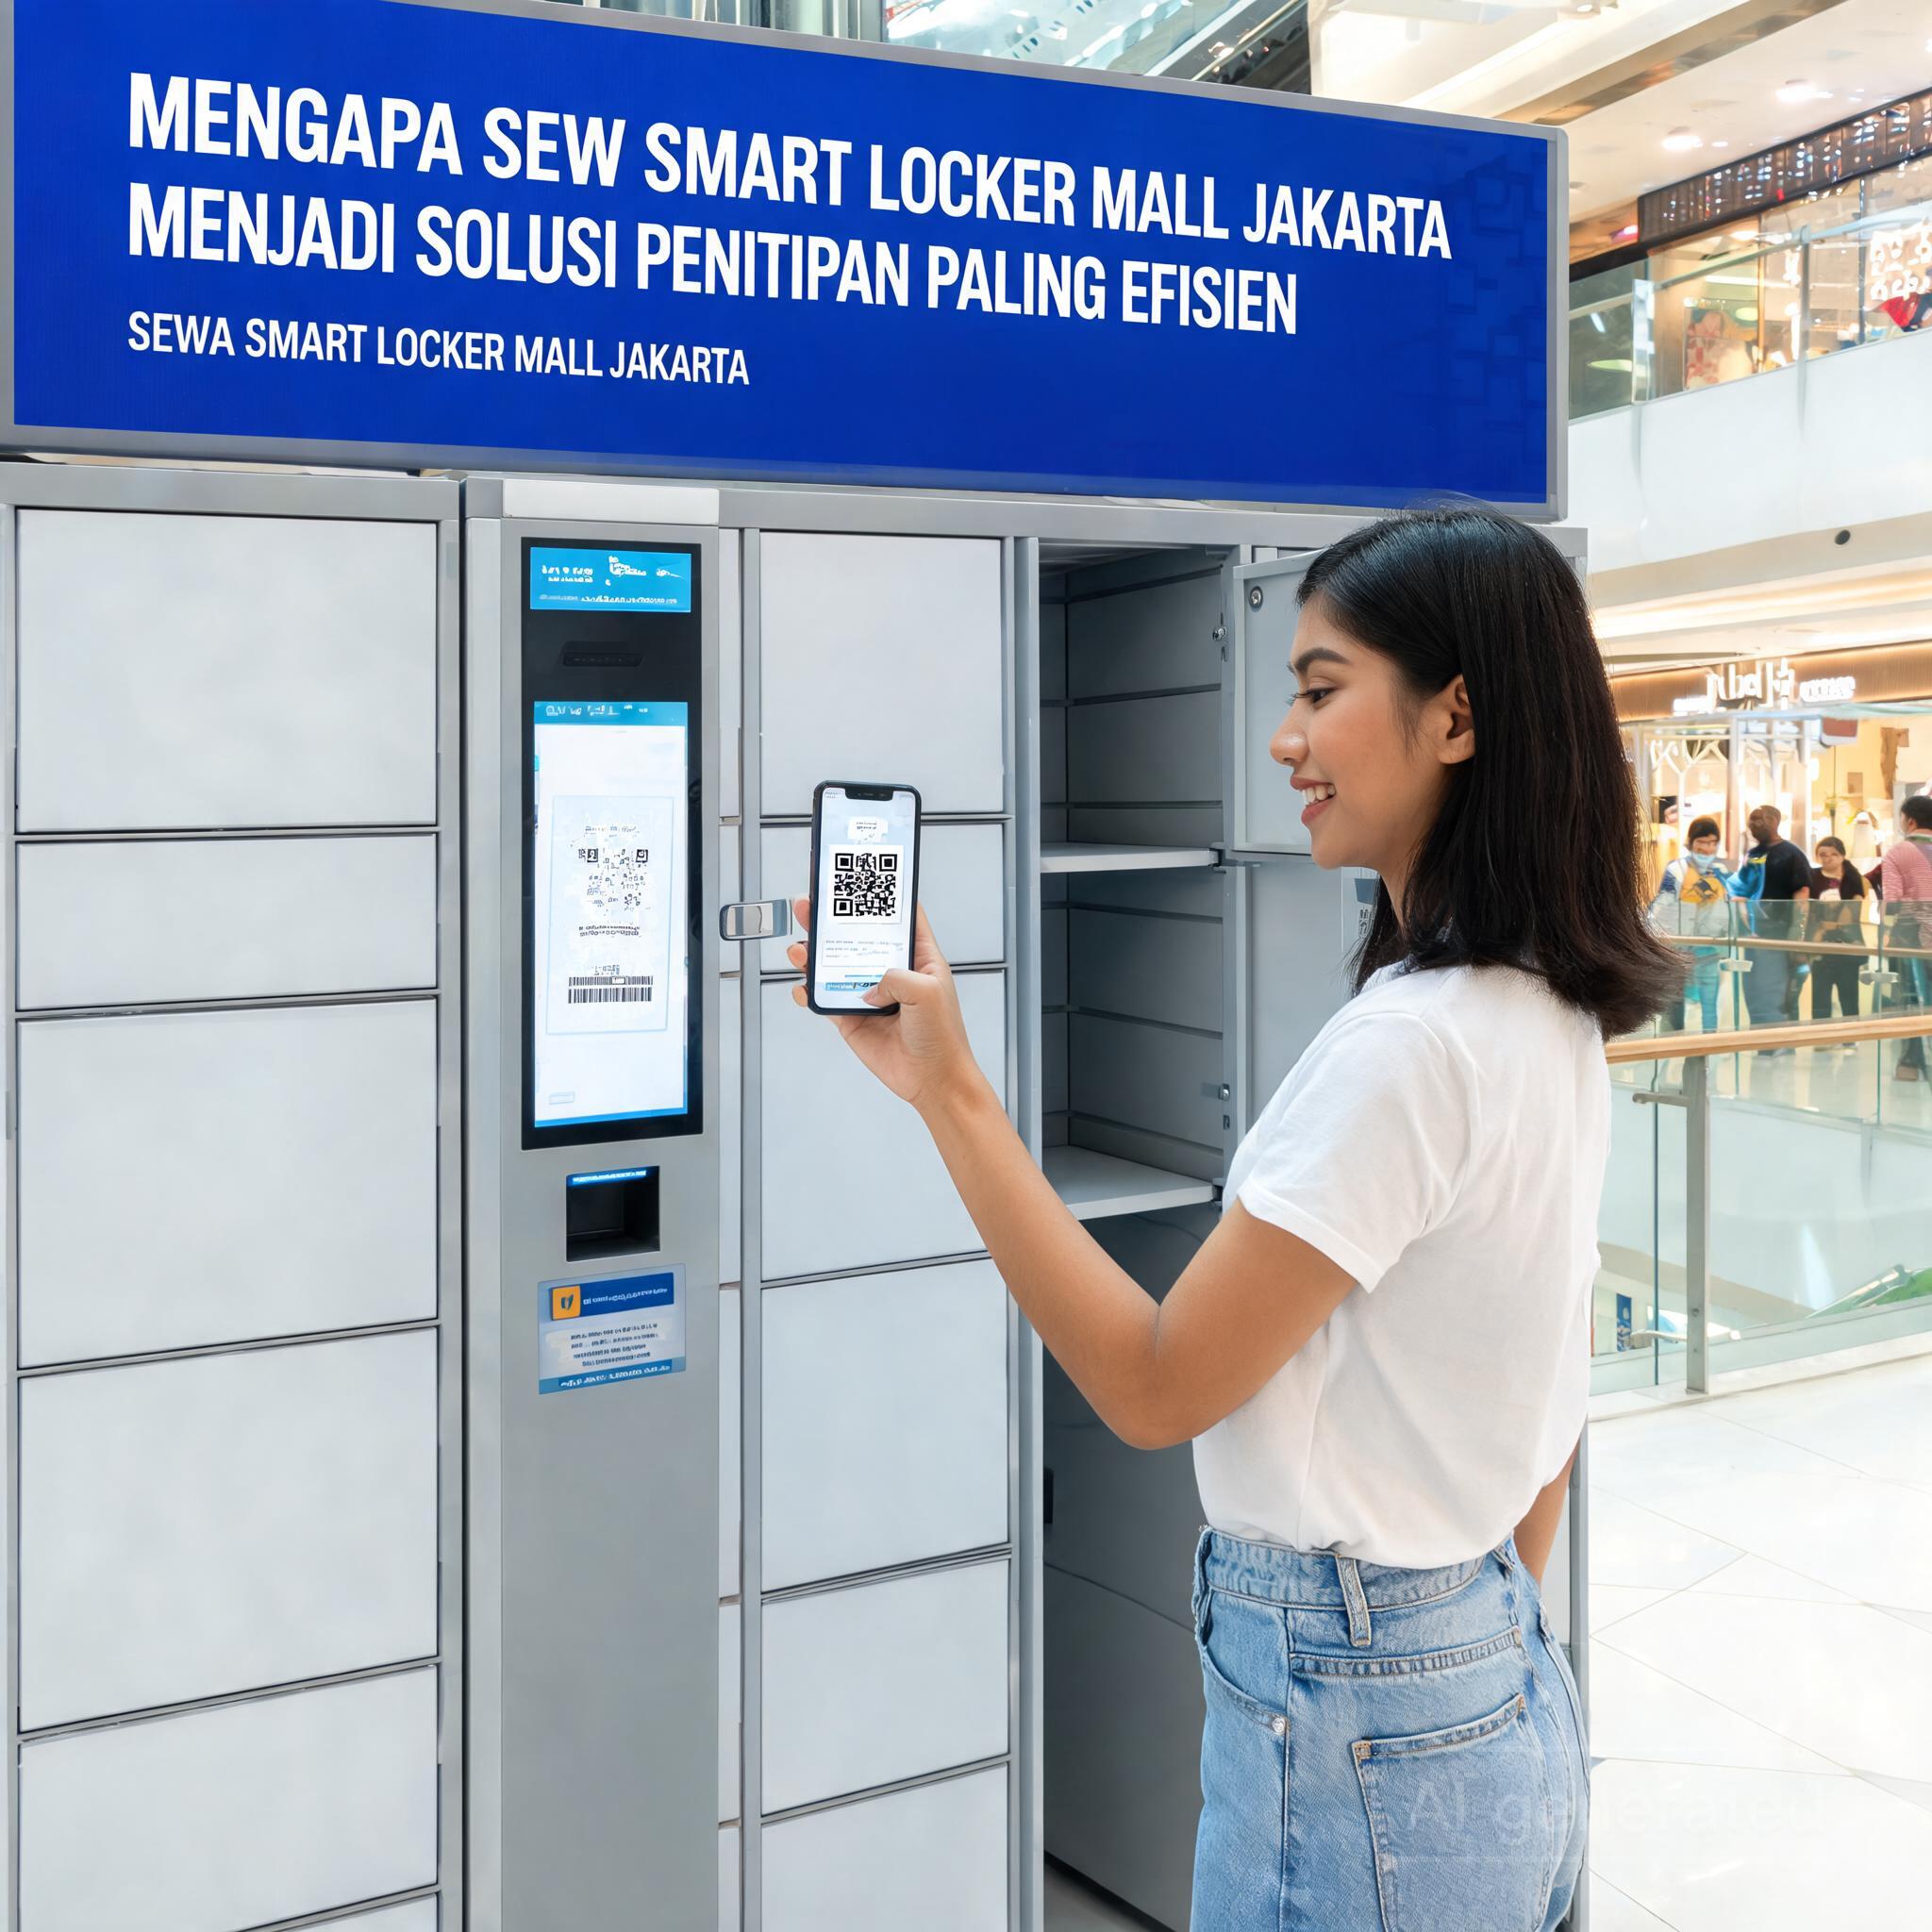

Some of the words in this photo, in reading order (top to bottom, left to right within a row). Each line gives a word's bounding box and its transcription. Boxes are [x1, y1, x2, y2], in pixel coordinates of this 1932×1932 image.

[129, 72, 463, 175] MENGAPA
[483, 107, 626, 188] SEW
[644, 122, 852, 206] SMART
[870, 144, 1075, 226] LOCKER
[1092, 165, 1229, 240] MALL
[1242, 183, 1453, 259] JAKARTA
[129, 182, 394, 273] MENJADI
[415, 205, 617, 288] SOLUSI
[637, 222, 909, 307] PENITIPAN
[927, 245, 1106, 320] PALING
[1122, 259, 1297, 335] EFISIEN
[127, 310, 236, 357] SEWA
[244, 318, 368, 362] SMART
[377, 326, 505, 371] LOCKER
[515, 335, 604, 377] MALL
[609, 341, 750, 385] JAKARTA
